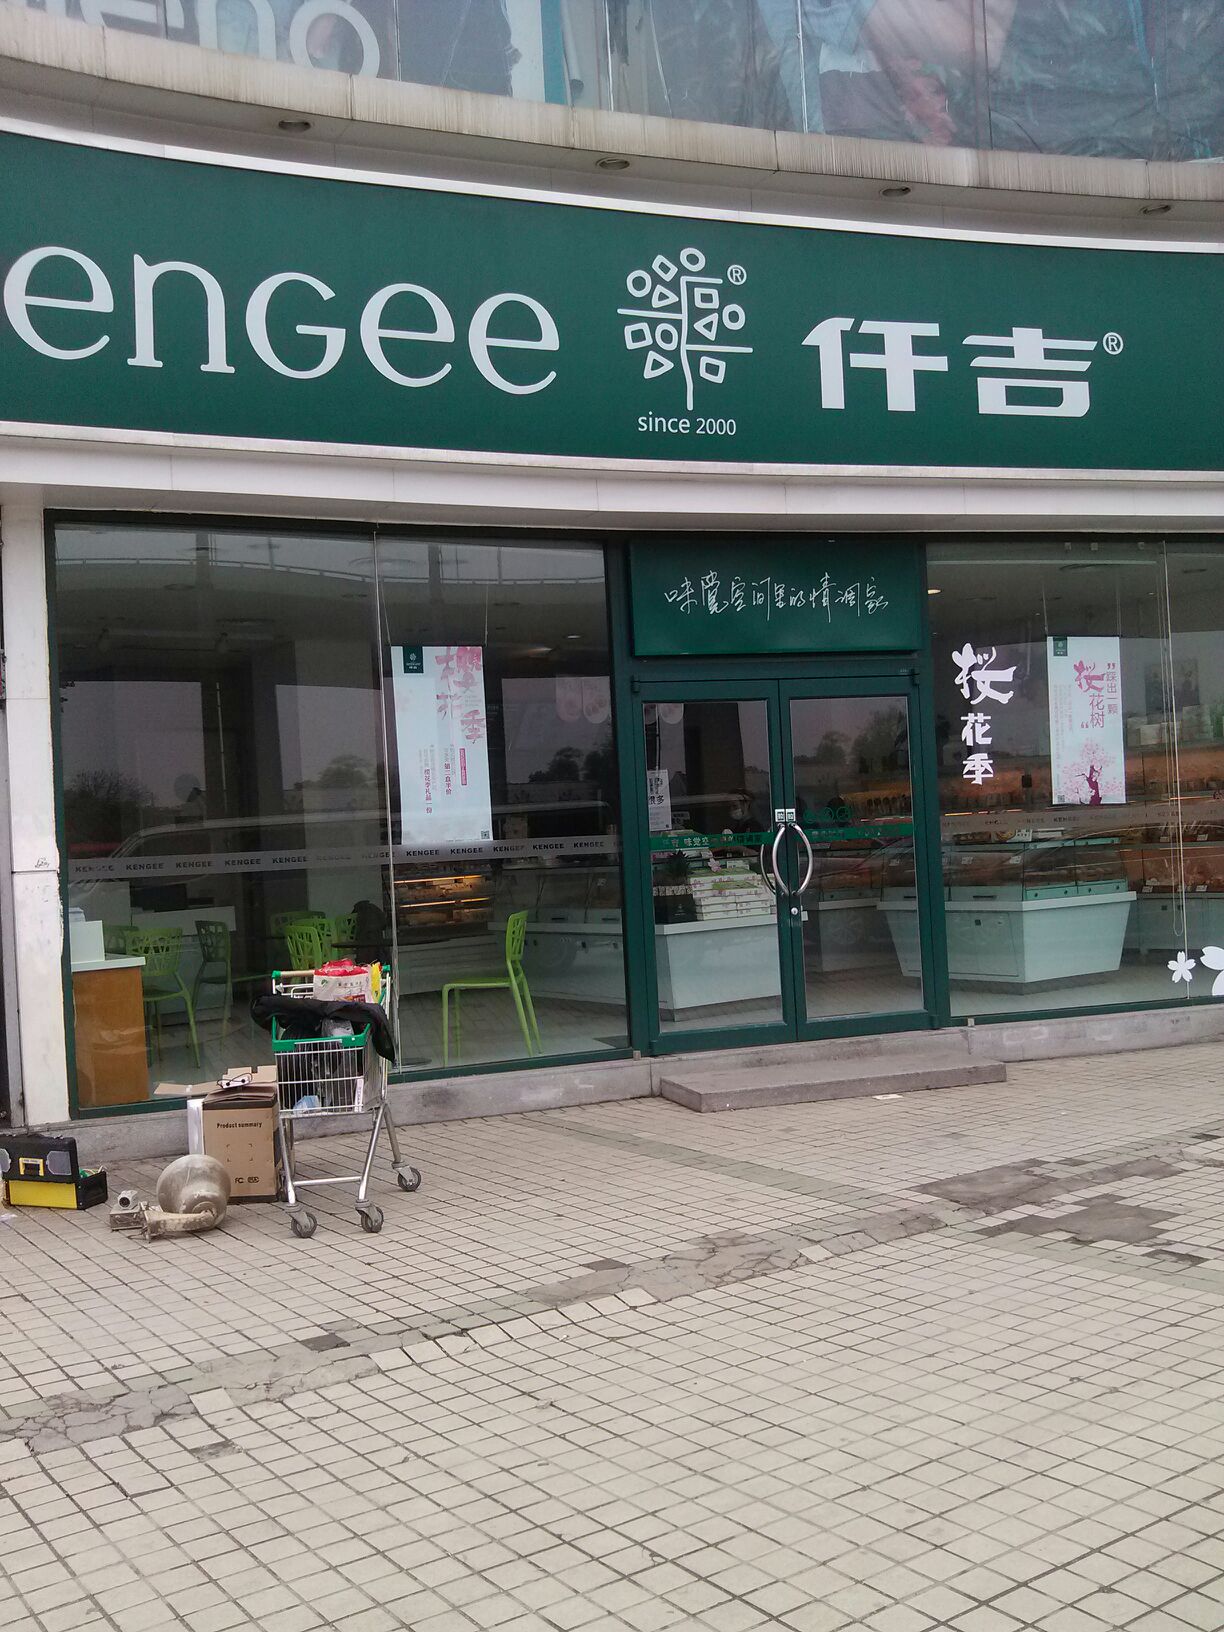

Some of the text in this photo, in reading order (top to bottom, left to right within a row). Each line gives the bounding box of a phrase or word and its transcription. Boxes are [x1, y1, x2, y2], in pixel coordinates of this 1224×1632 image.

[801, 317, 1098, 417] 仟吉
[638, 411, 737, 435] since 2000
[125, 862, 165, 871] KENGEE
[175, 860, 212, 869] KENGEE
[224, 858, 262, 866] KENGEE
[406, 849, 440, 857] KENGEE
[450, 847, 484, 855] KENGEE
